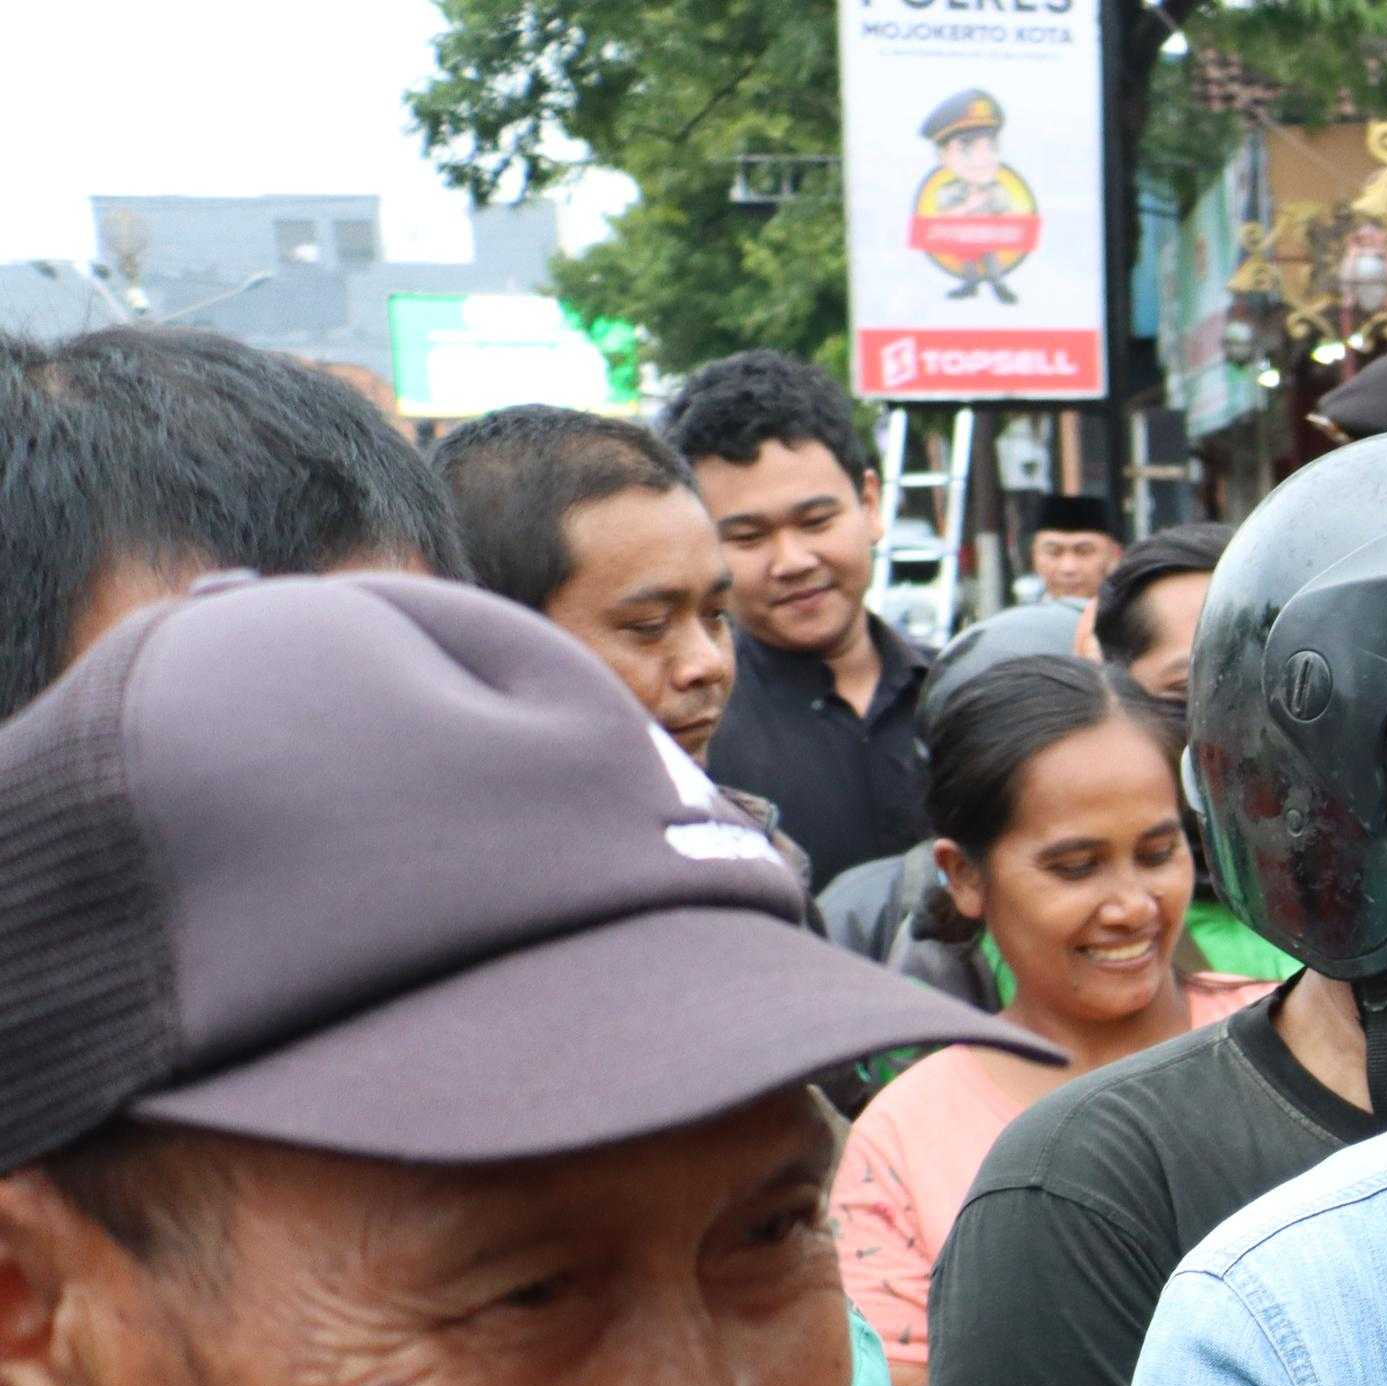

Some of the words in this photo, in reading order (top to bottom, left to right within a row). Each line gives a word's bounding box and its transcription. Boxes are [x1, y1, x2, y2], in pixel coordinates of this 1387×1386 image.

[862, 21, 1007, 43] MOJOKERTO
[1015, 27, 1072, 44] KOTA
[921, 349, 1078, 377] TOPSELL
